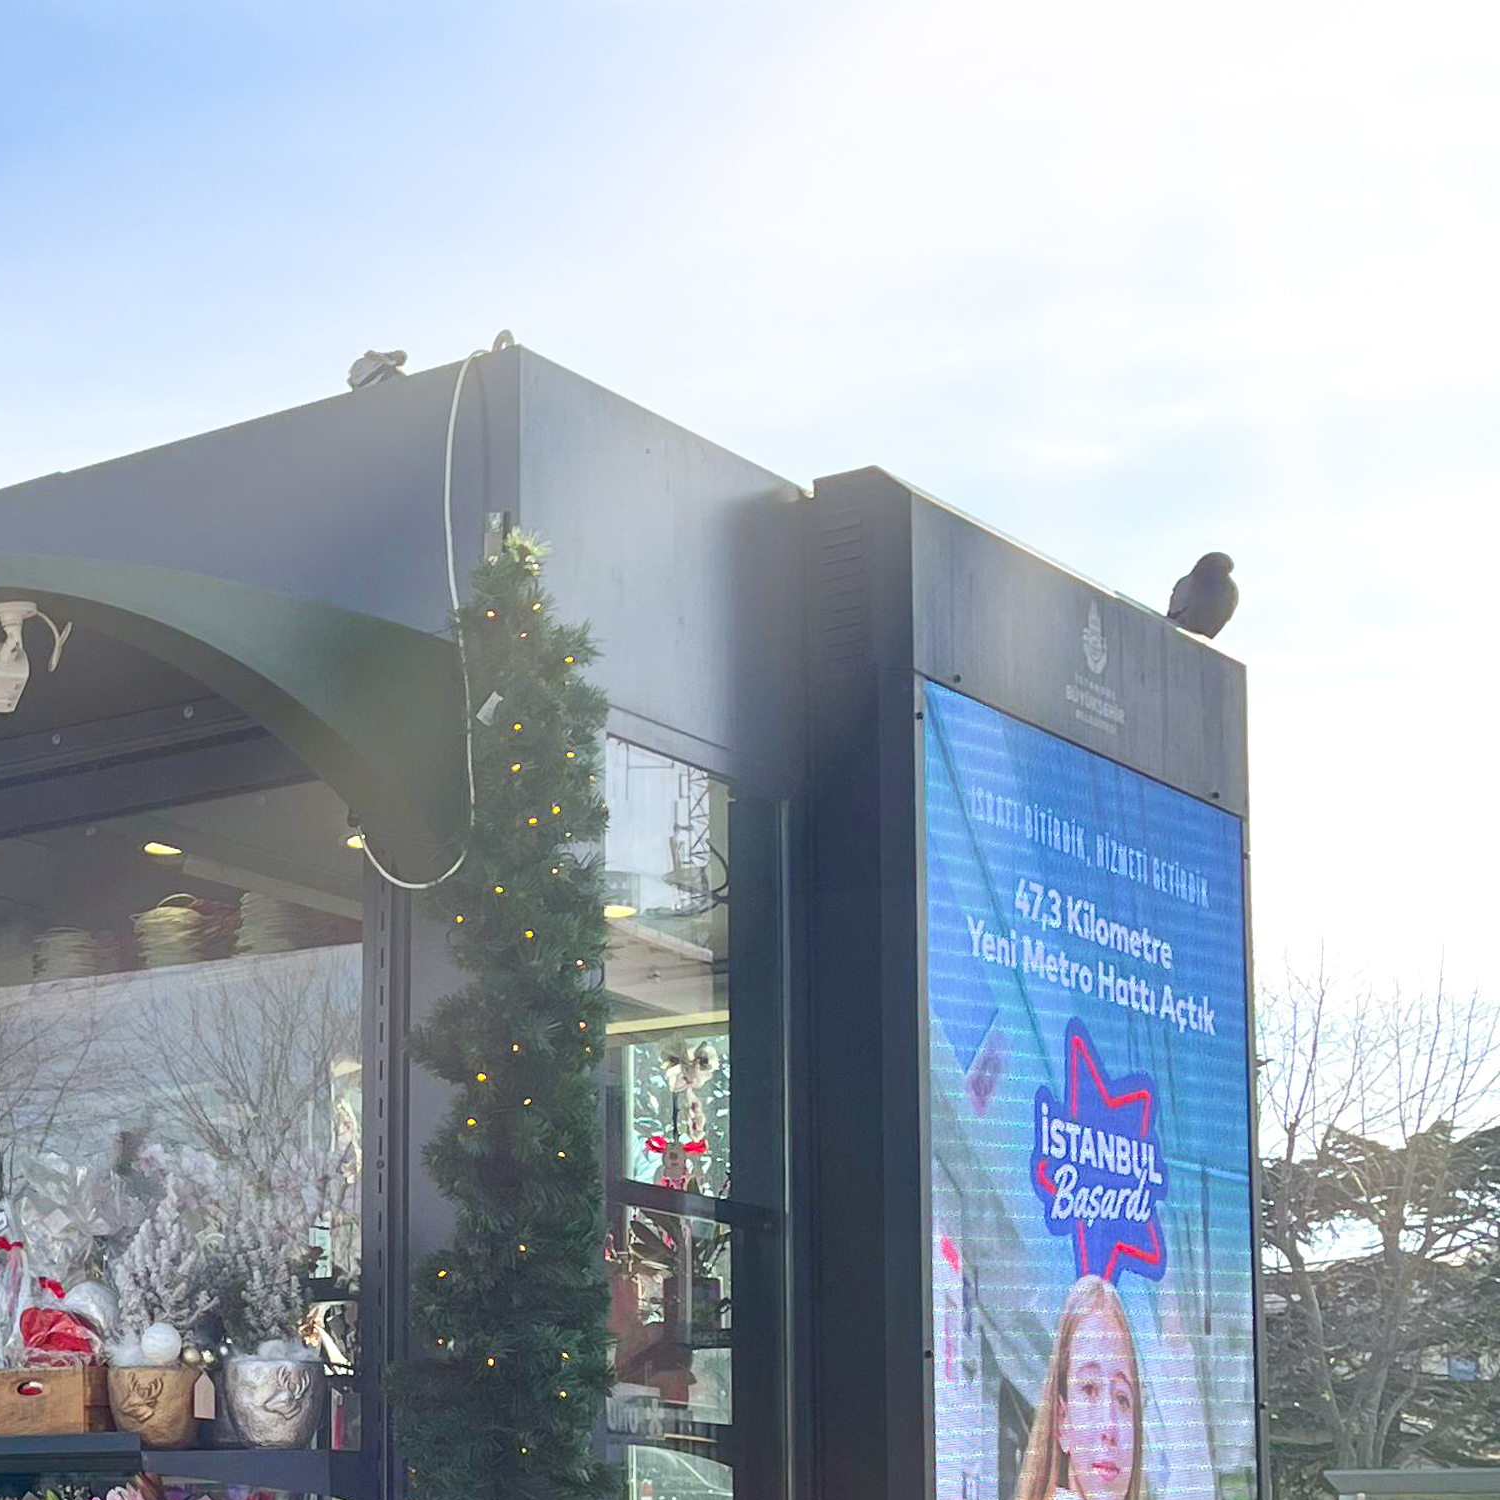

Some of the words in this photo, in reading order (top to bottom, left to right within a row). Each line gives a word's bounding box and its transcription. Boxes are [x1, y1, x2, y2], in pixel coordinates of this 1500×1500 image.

[1015, 878, 1062, 931] 47,3
[1067, 896, 1174, 969] Kilometre
[967, 915, 1017, 969] Yeni
[1023, 936, 1093, 994] Metro
[1098, 961, 1156, 1015] Hattı
[1160, 985, 1215, 1035] Açtık
[1040, 1103, 1163, 1185] İSTANBUL
[1051, 1163, 1151, 1227] Başardı
